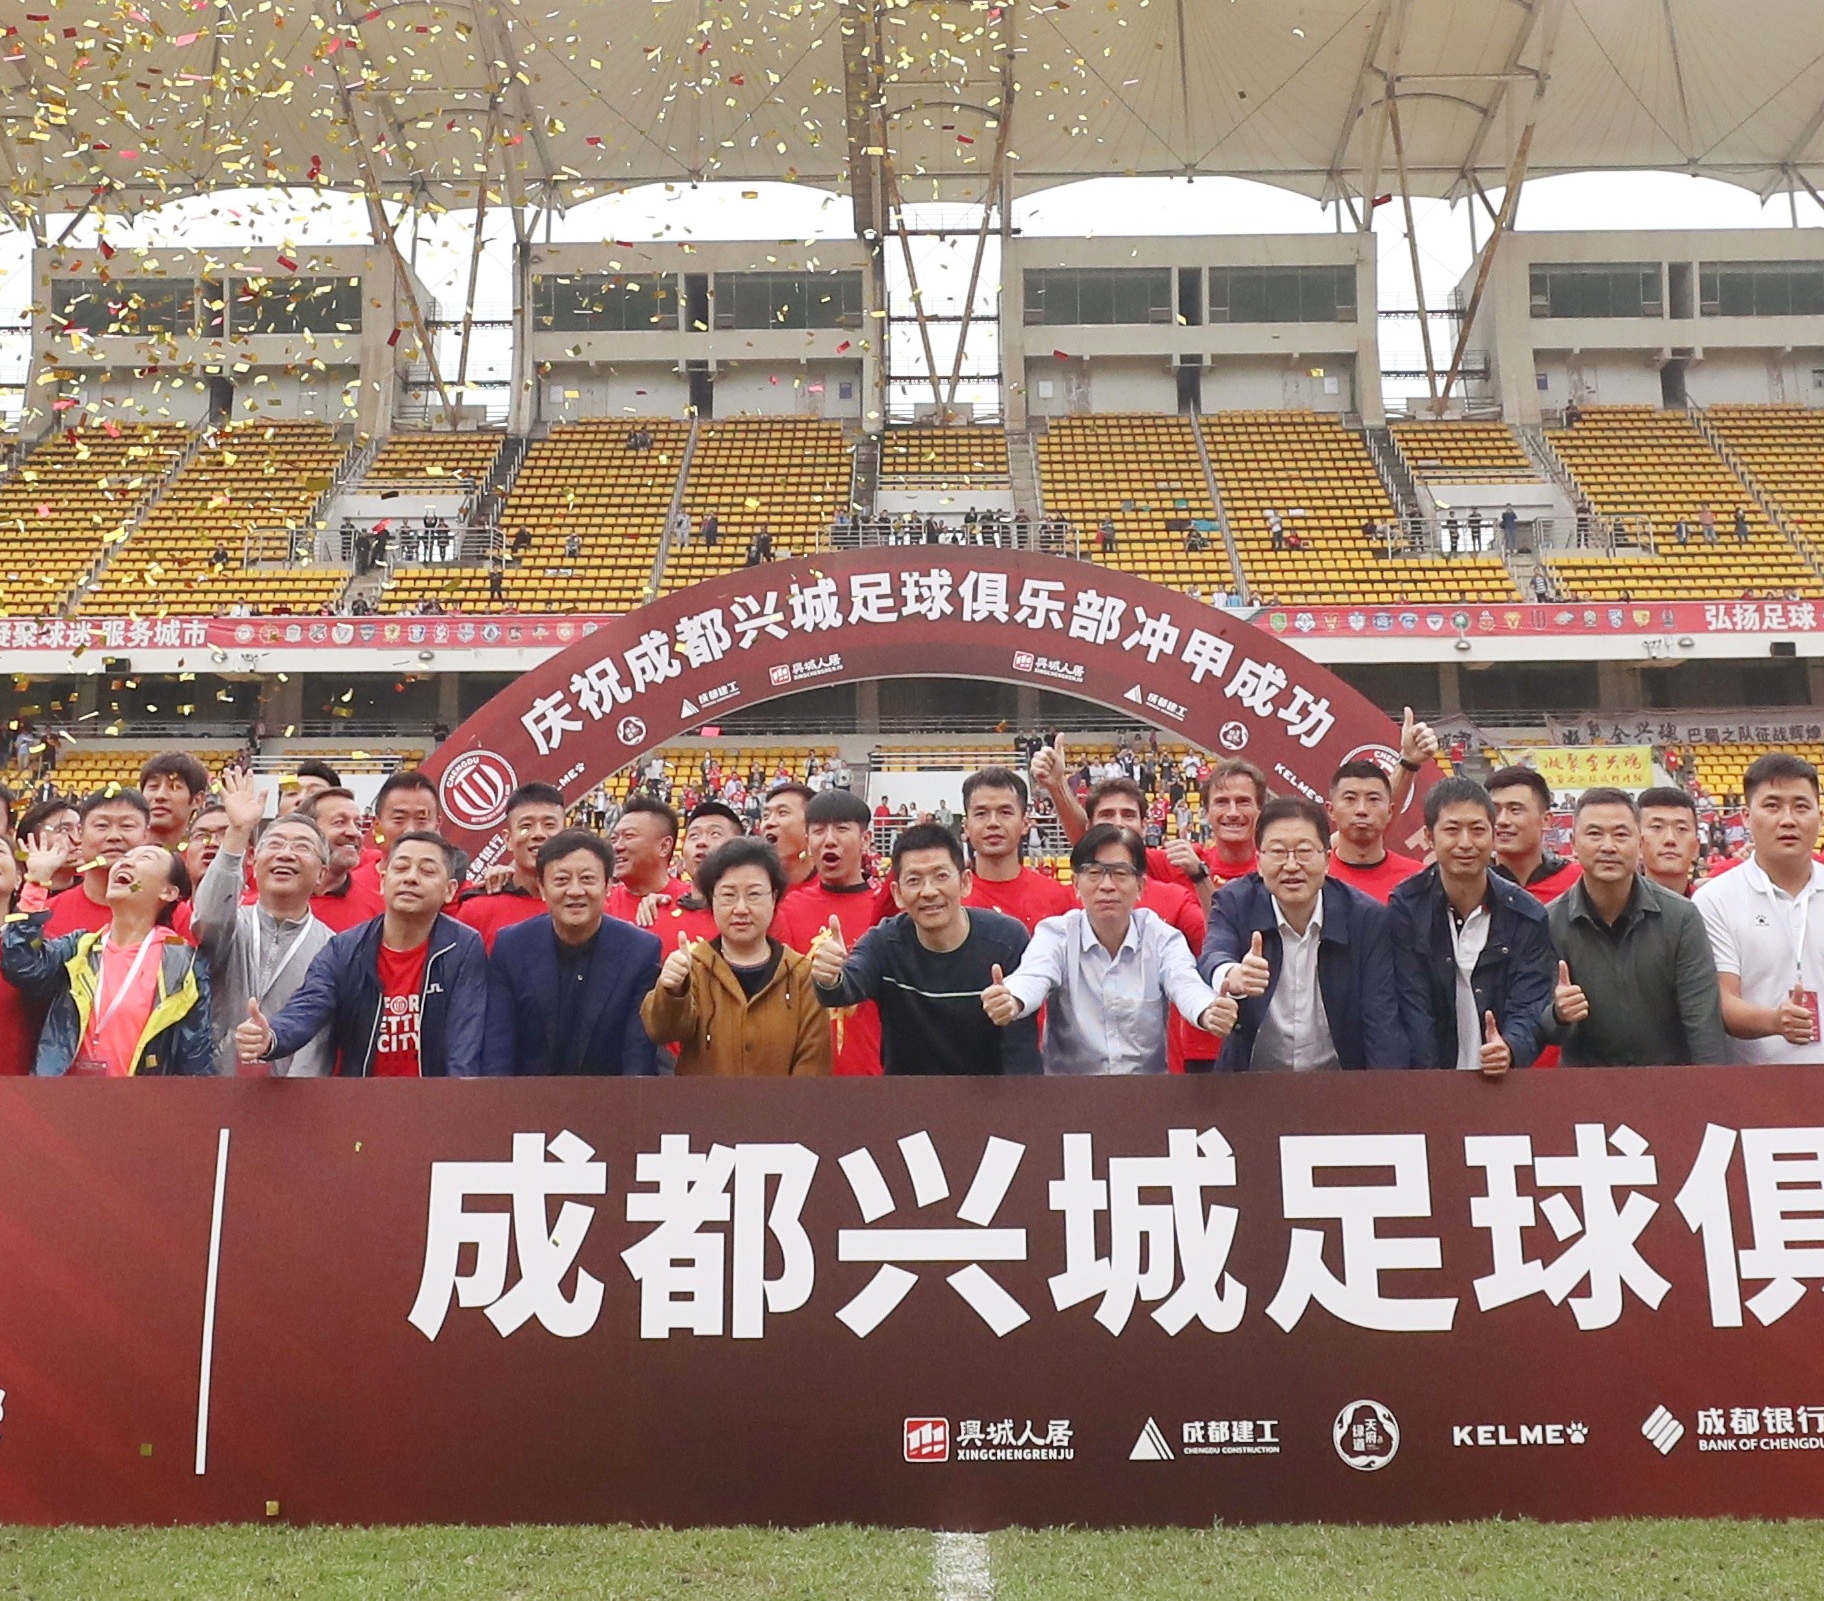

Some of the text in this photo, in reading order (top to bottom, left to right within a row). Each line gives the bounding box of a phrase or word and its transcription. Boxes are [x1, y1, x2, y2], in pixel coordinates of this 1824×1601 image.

[1705, 604, 1817, 631] 弘扬足球
[102, 620, 209, 647] 服务城市
[521, 568, 1335, 755] 庆祝成都兴城足球俱乐部冲甲成功
[1274, 762, 1316, 800] KELME
[1182, 1420, 1279, 1443] 成都建工
[1452, 1423, 1564, 1446] KELME
[957, 1448, 1074, 1461] XINGCHENGRENJU
[1183, 1446, 1280, 1455] CHENGDU CONSTRUCTION
[1698, 1439, 1737, 1451] BANK
[1738, 1438, 1758, 1451] OF
